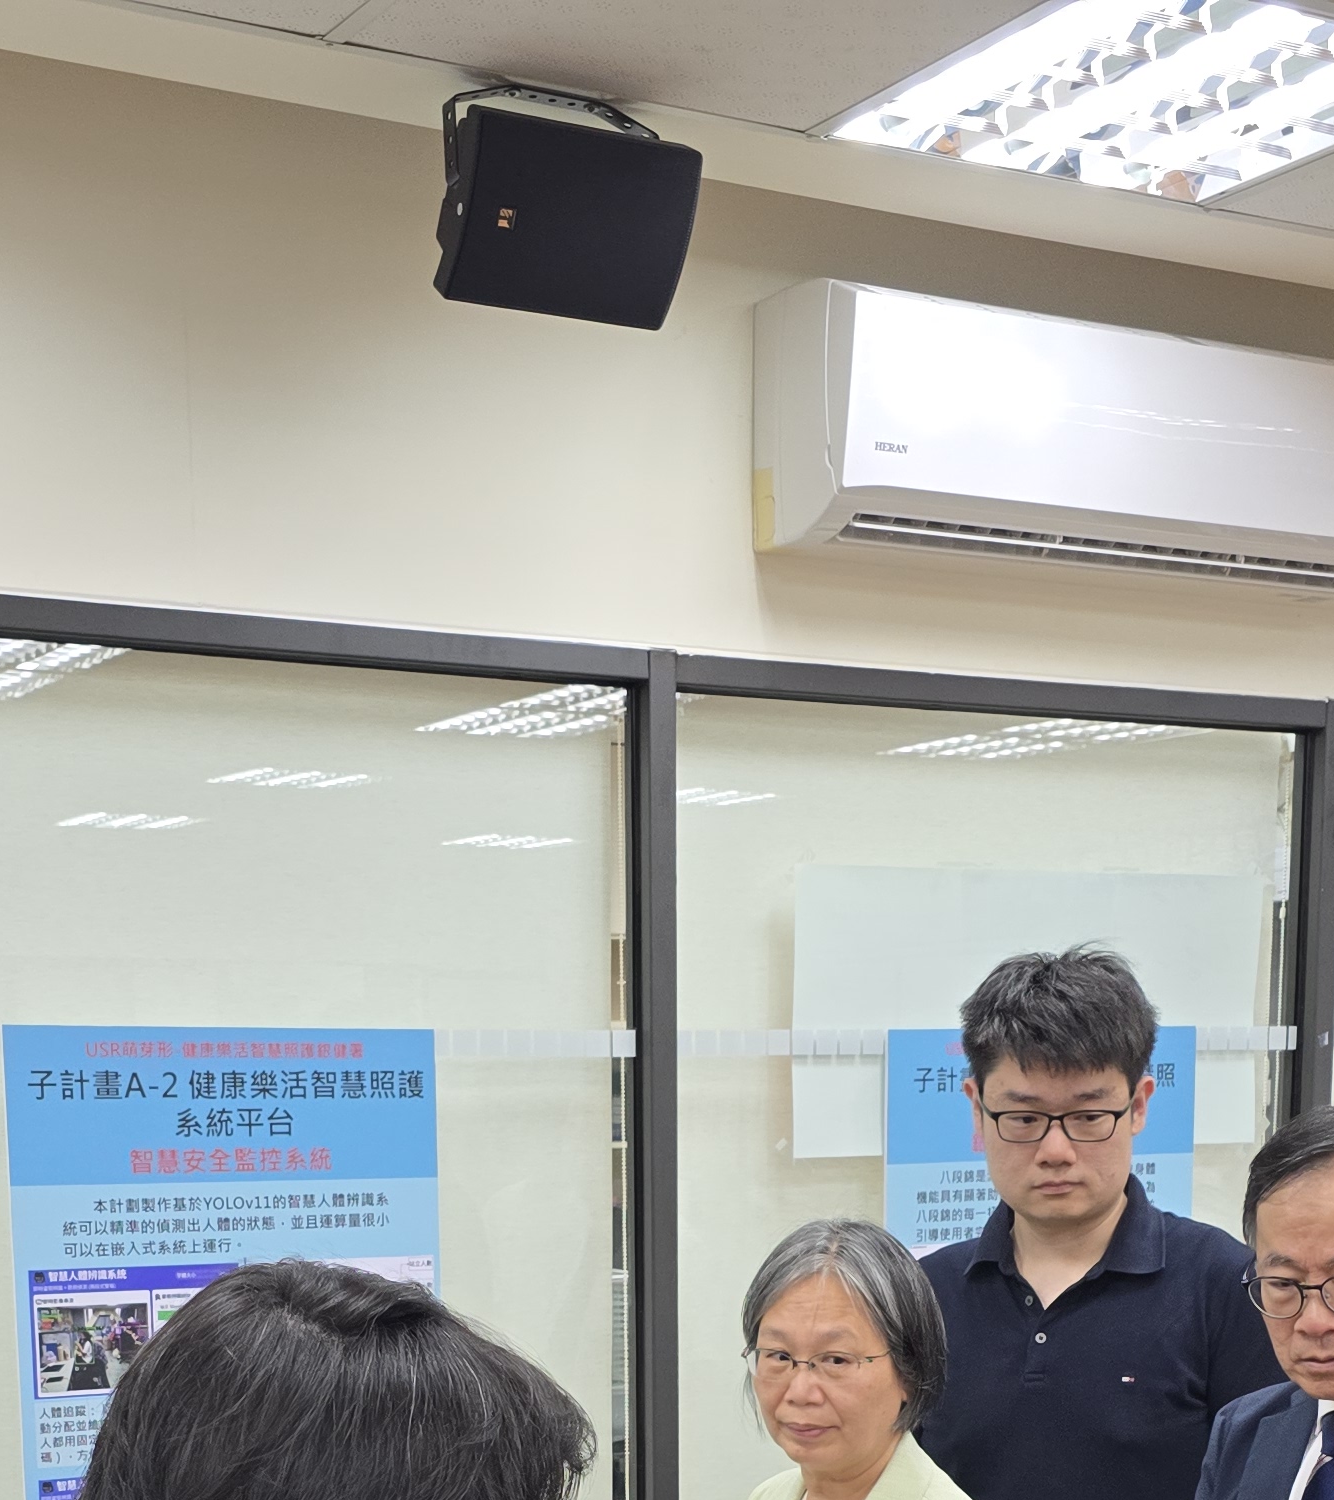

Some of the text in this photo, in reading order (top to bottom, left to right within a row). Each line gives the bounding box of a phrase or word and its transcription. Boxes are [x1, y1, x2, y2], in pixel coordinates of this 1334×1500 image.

[874, 441, 908, 454] HERAN
[28, 1070, 424, 1100] 子計畫A-2 健康樂活智慧照護
[175, 1107, 294, 1138] 系統平台
[130, 1147, 332, 1174] 智慧安全監控系統
